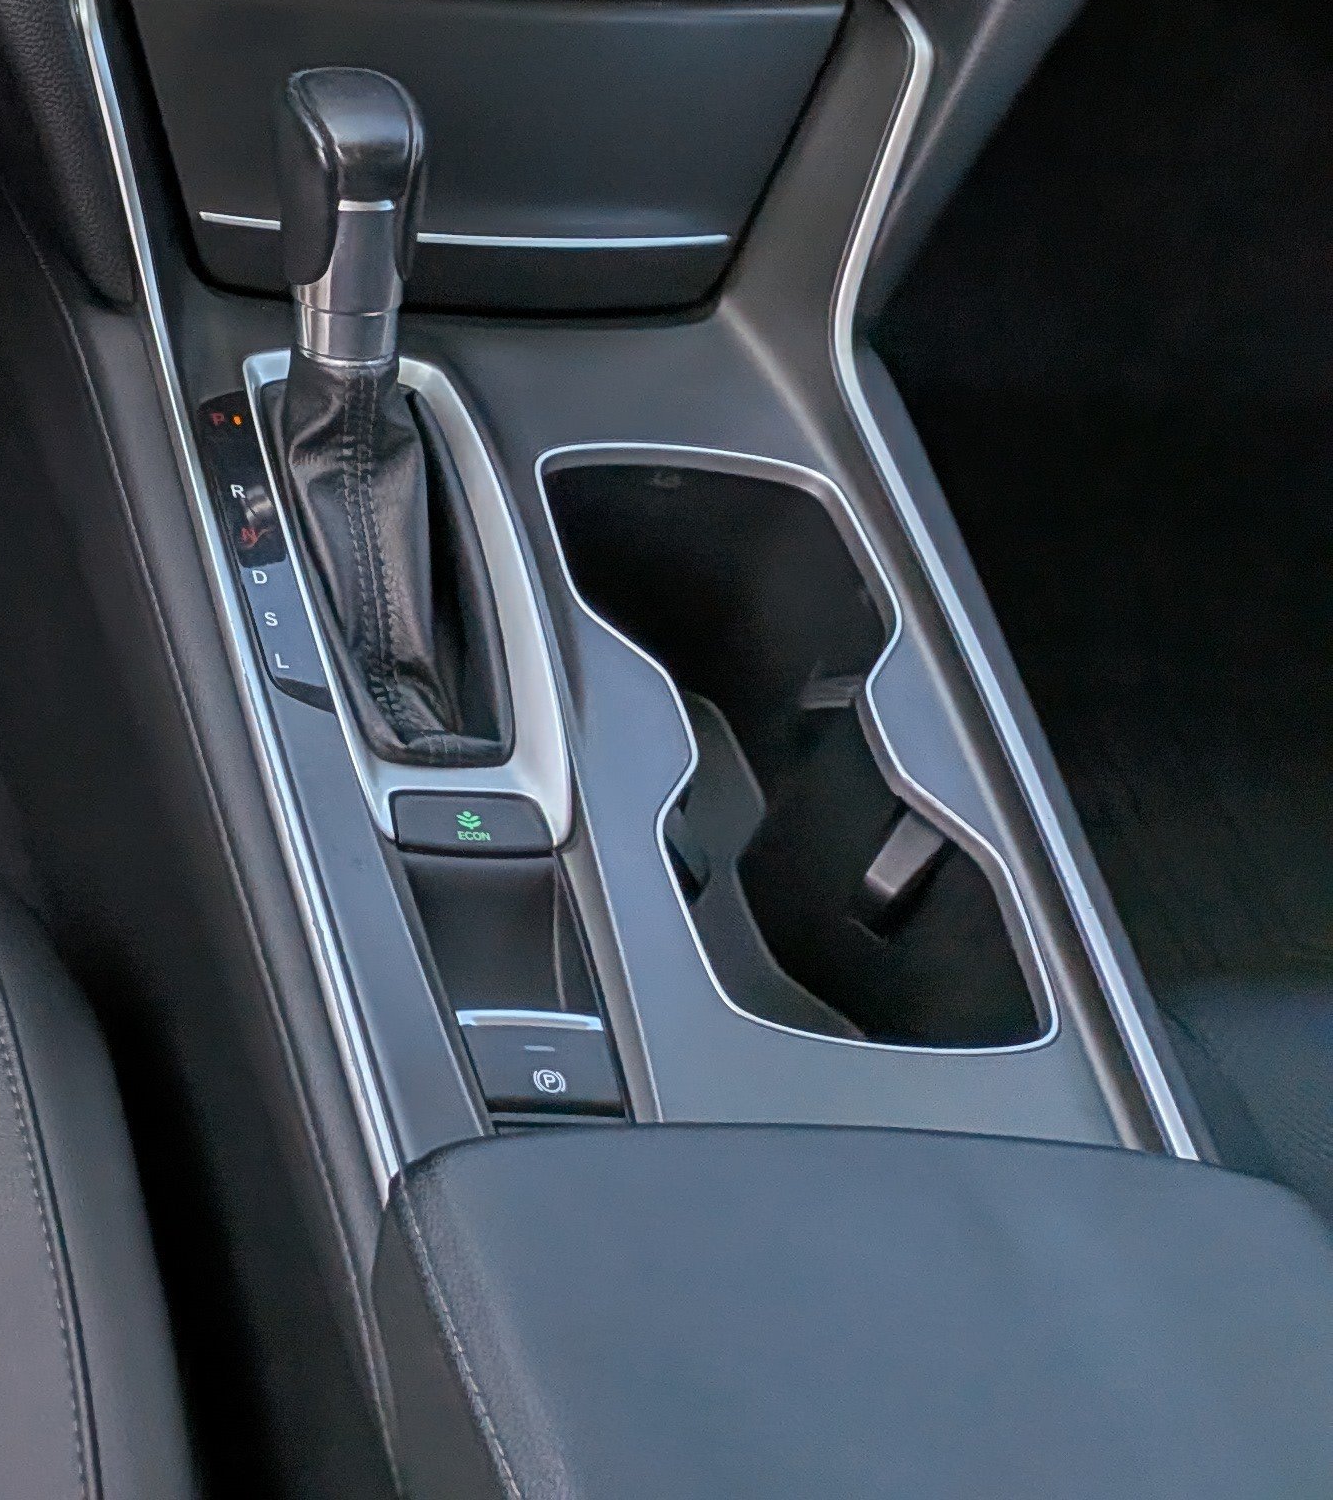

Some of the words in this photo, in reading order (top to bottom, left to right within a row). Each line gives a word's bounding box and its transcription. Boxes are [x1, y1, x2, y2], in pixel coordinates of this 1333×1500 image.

[211, 412, 225, 426] P
[231, 484, 246, 500] R
[253, 570, 269, 586] D
[264, 611, 279, 628] S
[275, 653, 291, 670] L
[457, 830, 491, 842] ECON
